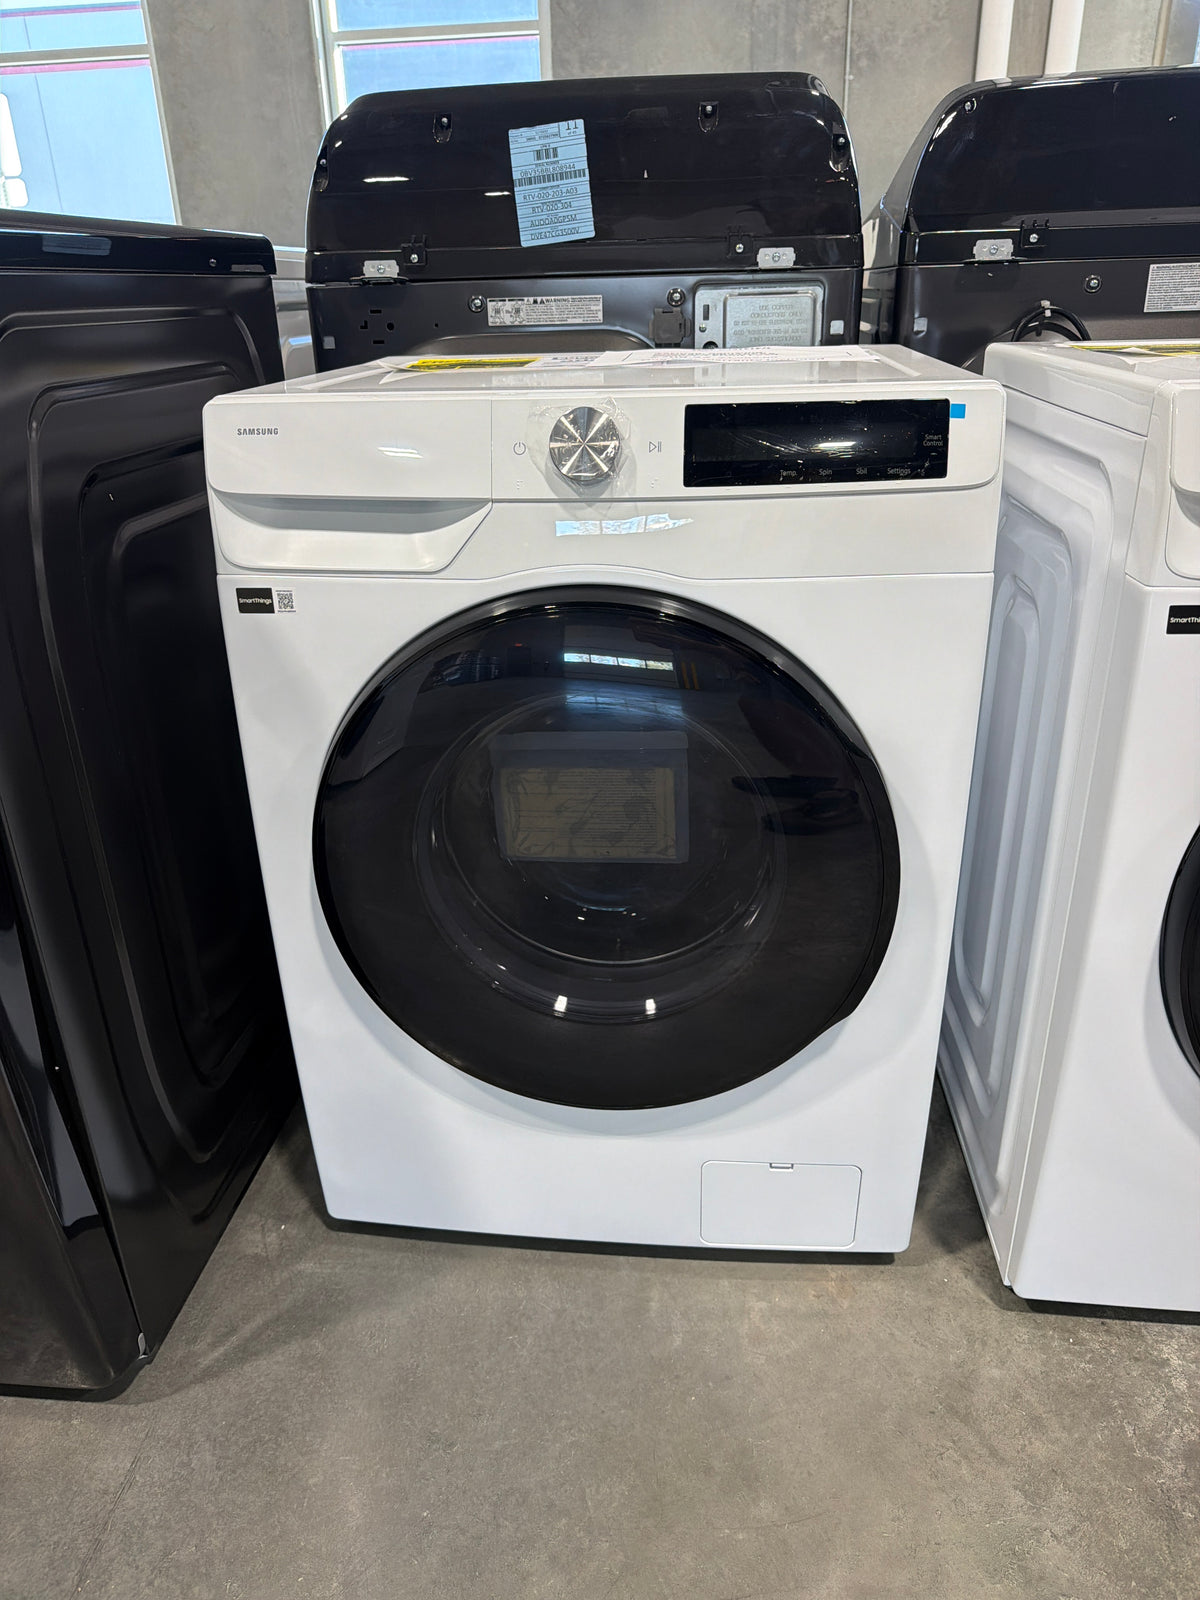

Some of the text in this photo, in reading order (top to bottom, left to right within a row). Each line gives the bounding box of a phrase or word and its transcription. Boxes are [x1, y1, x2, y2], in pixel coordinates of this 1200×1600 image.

[237, 428, 279, 436] SAMSUNG
[924, 433, 942, 441] Smart
[779, 467, 911, 477] Temp. Spin Soil Settings
[239, 597, 273, 605] SmartThings
